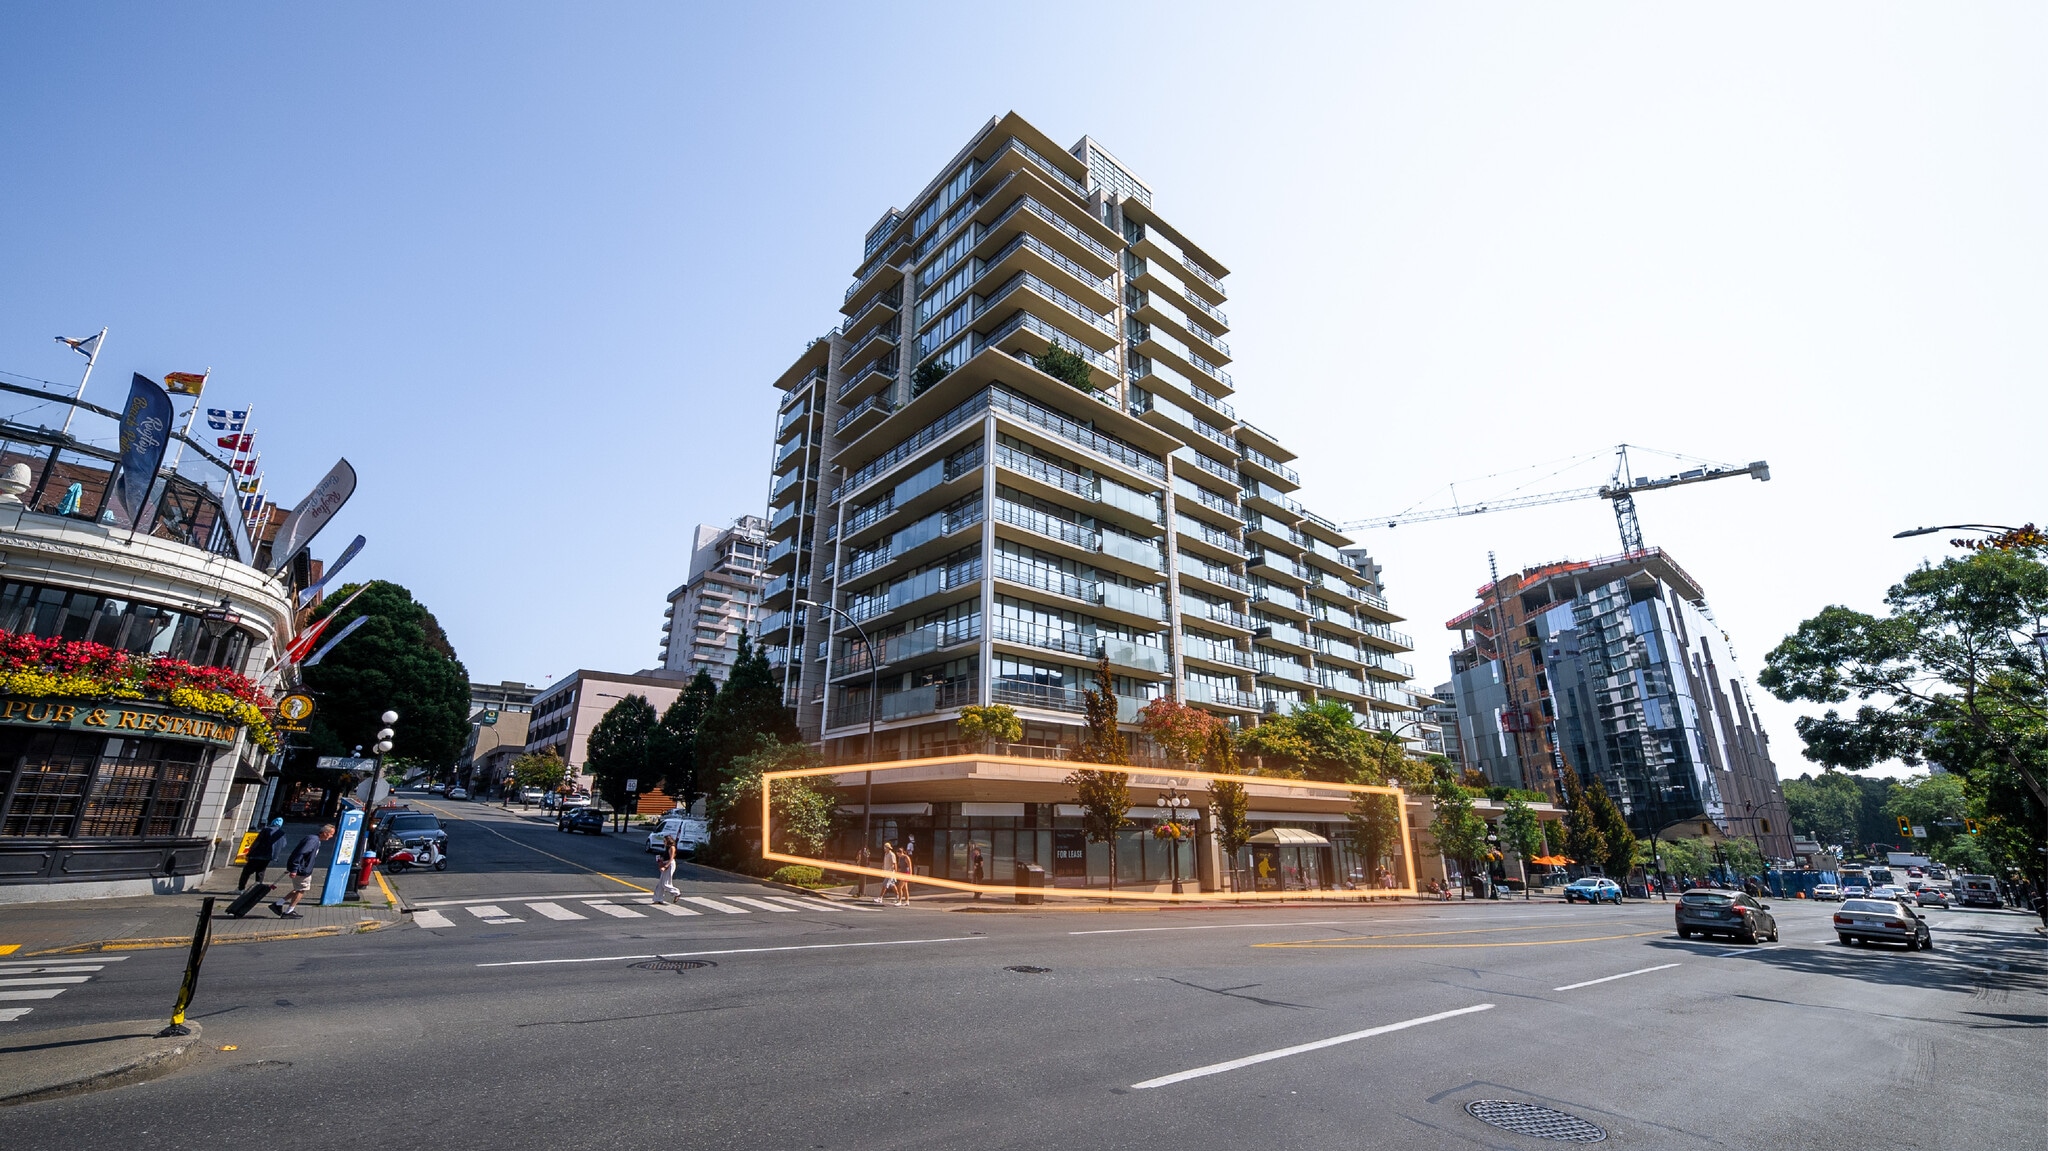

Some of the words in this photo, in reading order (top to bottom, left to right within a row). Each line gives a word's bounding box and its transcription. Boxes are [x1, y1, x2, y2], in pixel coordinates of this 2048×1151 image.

[127, 396, 148, 427] Beach
[133, 416, 163, 455] Rooftop
[312, 491, 341, 518] Rooftop
[0, 701, 76, 722] PUB
[85, 708, 111, 726] &
[117, 711, 236, 741] RESTAURANT
[348, 816, 357, 826] P
[1057, 850, 1067, 858] FOR
[1068, 850, 1082, 858] LEASE
